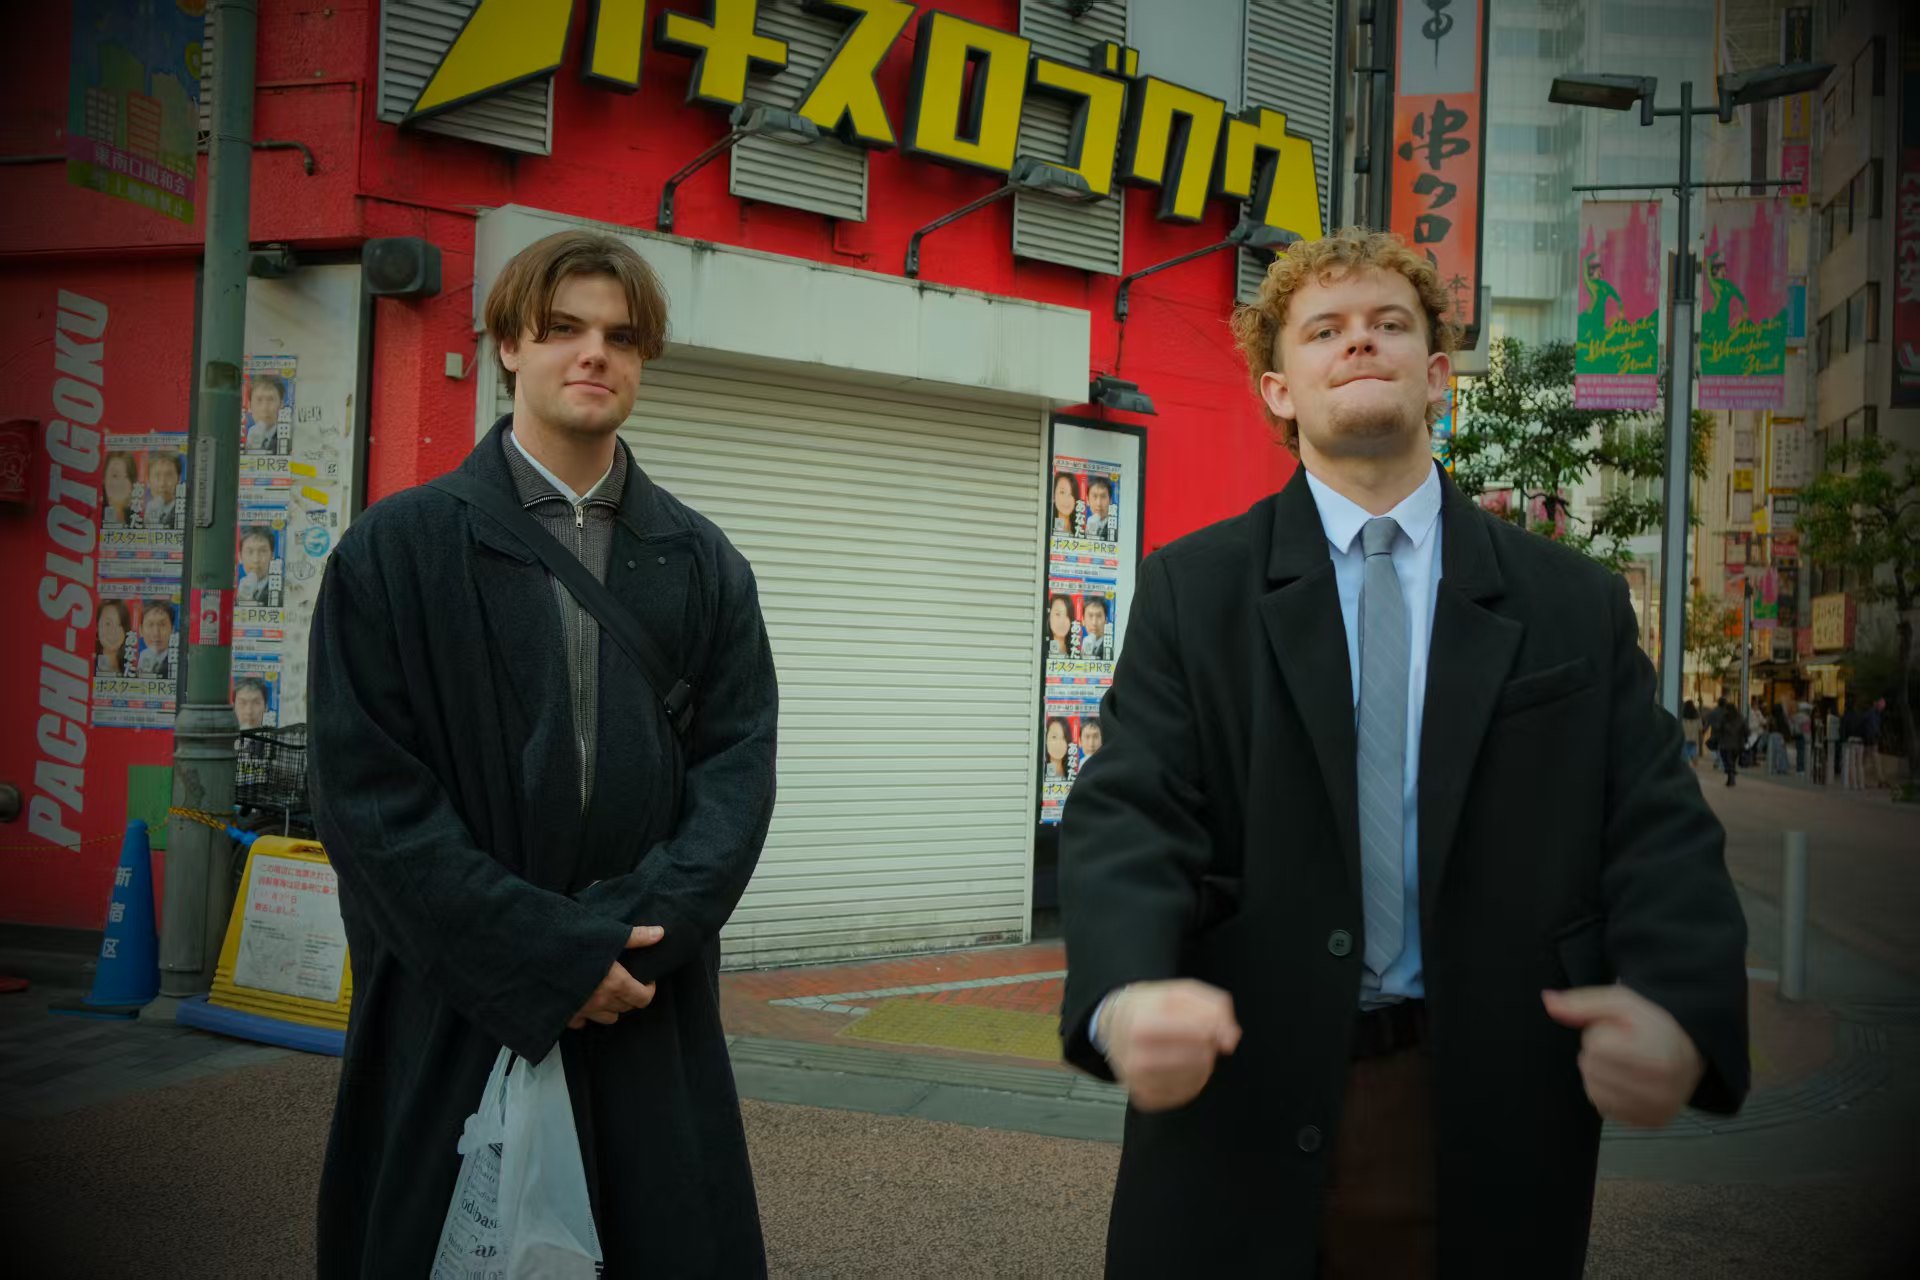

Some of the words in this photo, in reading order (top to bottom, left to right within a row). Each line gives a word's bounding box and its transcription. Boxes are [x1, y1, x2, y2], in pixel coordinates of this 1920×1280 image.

[130, 482, 145, 529] あなた
[1075, 499, 1086, 539] あなた
[103, 530, 147, 545] ポスター
[1053, 538, 1086, 550] ポスター
[124, 630, 138, 678] あなた
[1070, 620, 1081, 659] あなた
[1048, 661, 1083, 673] ポスター
[95, 680, 140, 694] ポスター
[101, 864, 133, 959] 新宿区
